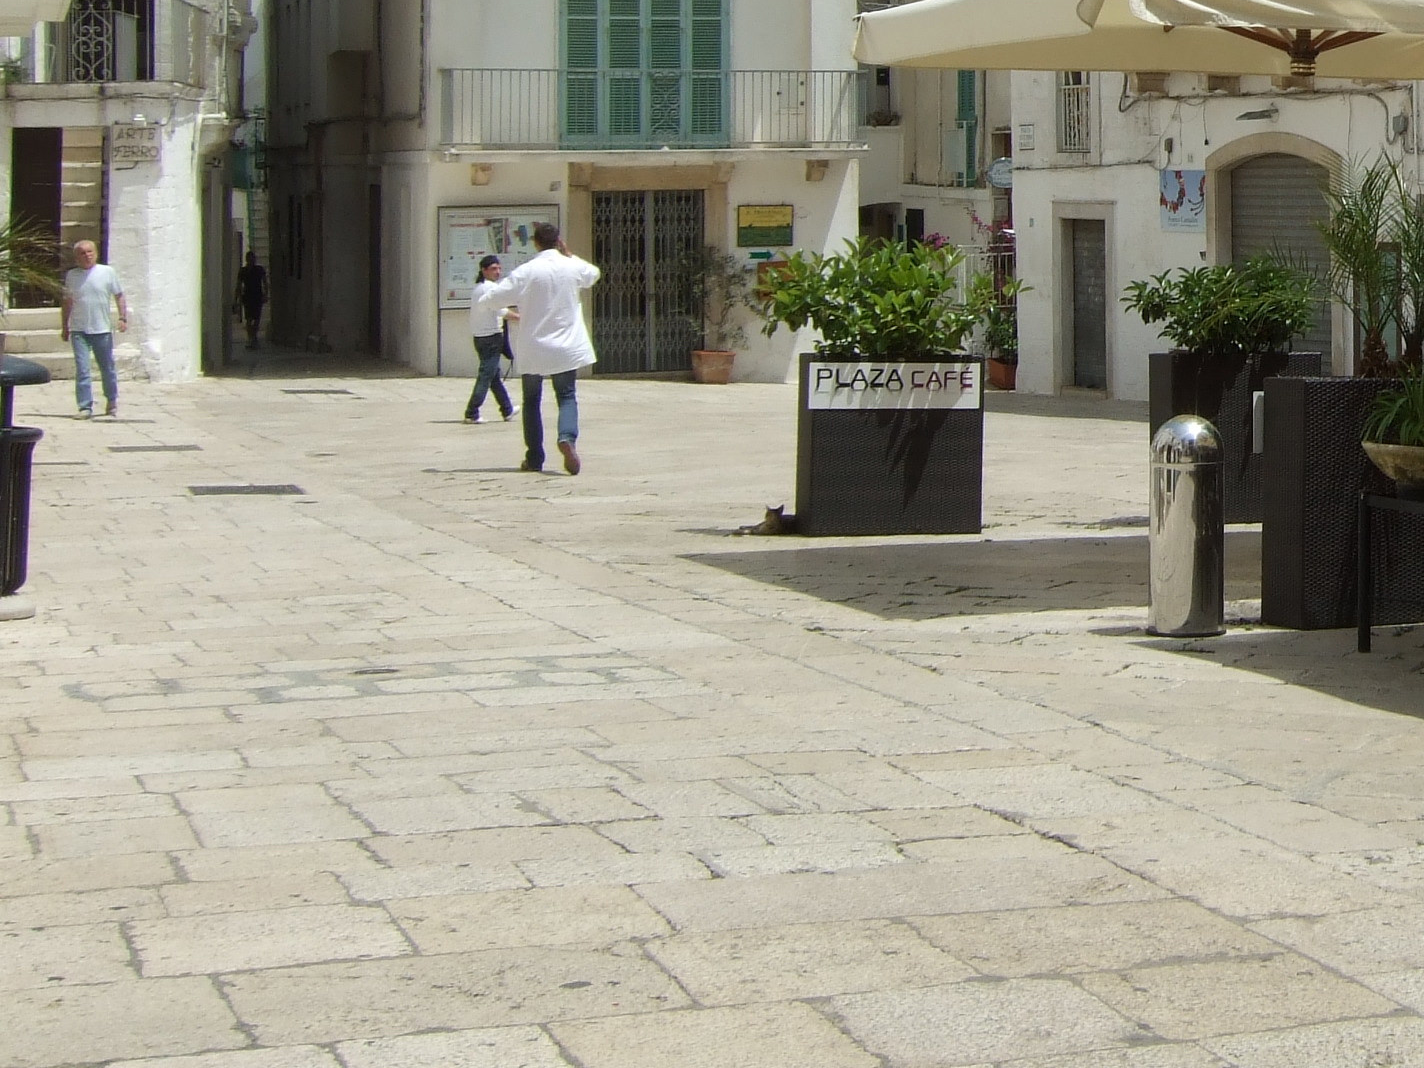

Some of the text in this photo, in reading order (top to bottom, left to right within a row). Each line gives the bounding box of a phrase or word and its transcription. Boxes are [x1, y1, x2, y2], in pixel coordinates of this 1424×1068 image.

[115, 128, 156, 141] ARTE
[113, 145, 159, 158] FERRO
[816, 366, 973, 391] PLAZA CAFÉ
